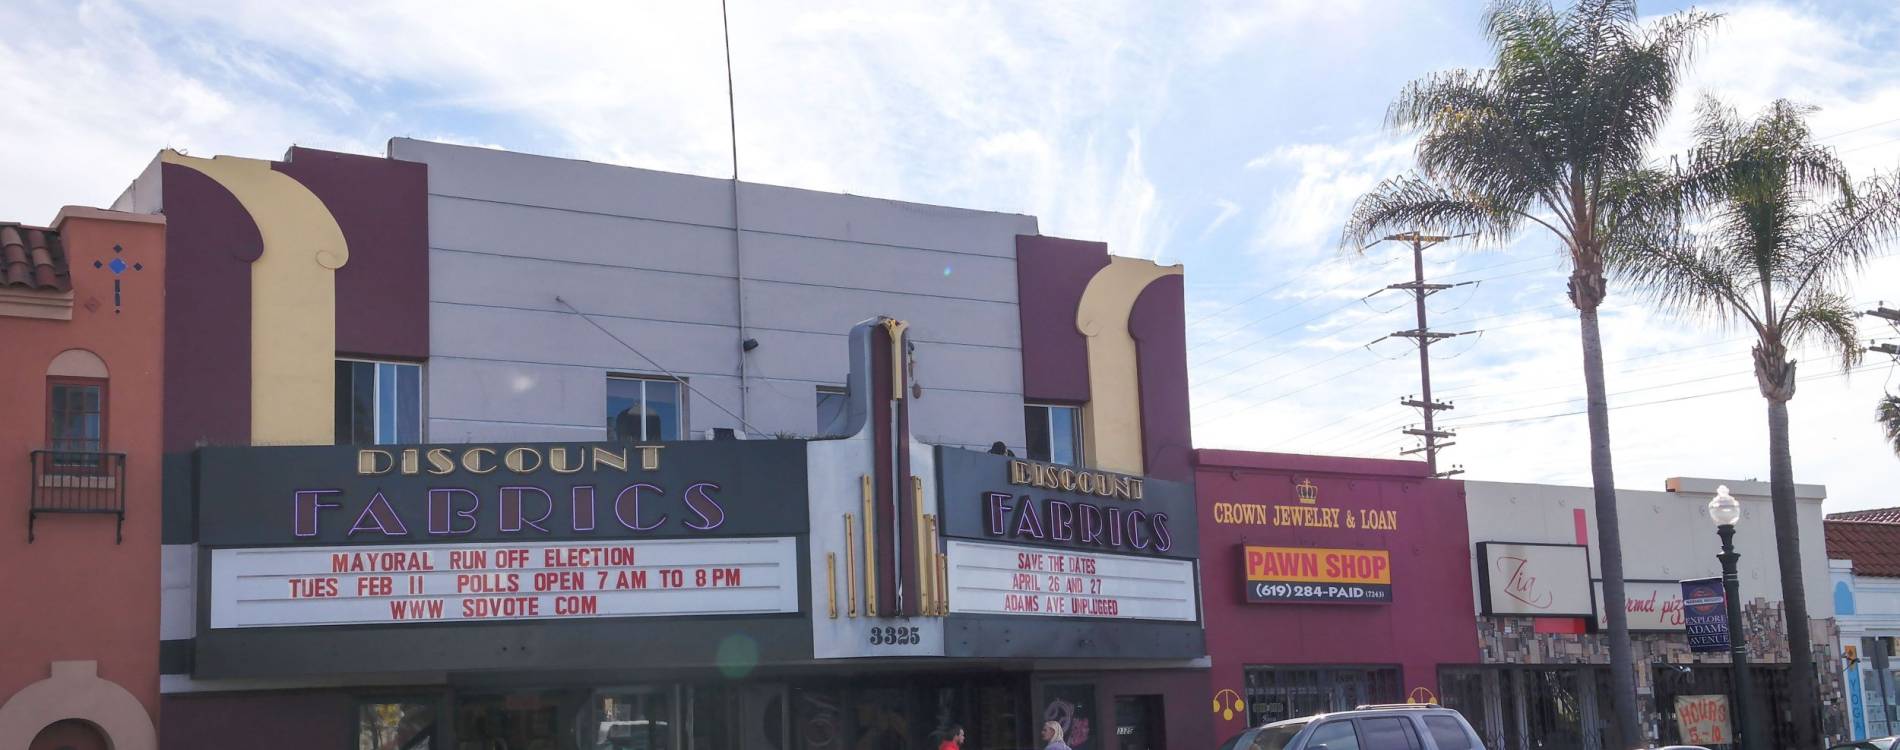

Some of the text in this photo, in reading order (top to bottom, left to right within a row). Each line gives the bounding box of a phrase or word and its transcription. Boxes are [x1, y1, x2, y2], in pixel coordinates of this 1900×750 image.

[357, 445, 666, 475] DISCOUNT
[1010, 460, 1143, 500] DISCOUNT
[293, 482, 726, 537] FABRICS
[984, 491, 1172, 552] FABRICS
[1214, 502, 1397, 530] CROWN JEWELRY & LOAN
[332, 547, 635, 573] MAYORAL RUN OFF ELECTION
[1018, 553, 1096, 574] SAVE THE DATES
[1248, 551, 1387, 579] PAWN SHOP
[289, 568, 741, 598] TUES FEB 11 POLLS OPEN 7 AM TO 8 PM
[1013, 573, 1102, 595] APRIL 26 AND 27
[1256, 583, 1292, 598] (619)
[1294, 585, 1364, 598] 284-PAID
[390, 596, 598, 620] WWW SDVOTE COM
[1004, 594, 1119, 616] ADAMS AVE UNPLUGGED
[1686, 615, 1727, 625] EXPLORE
[1687, 624, 1728, 635] ADAMS
[870, 626, 920, 645] 3325
[1690, 635, 1729, 645] AVENUE
[1679, 699, 1726, 726] HOURS
